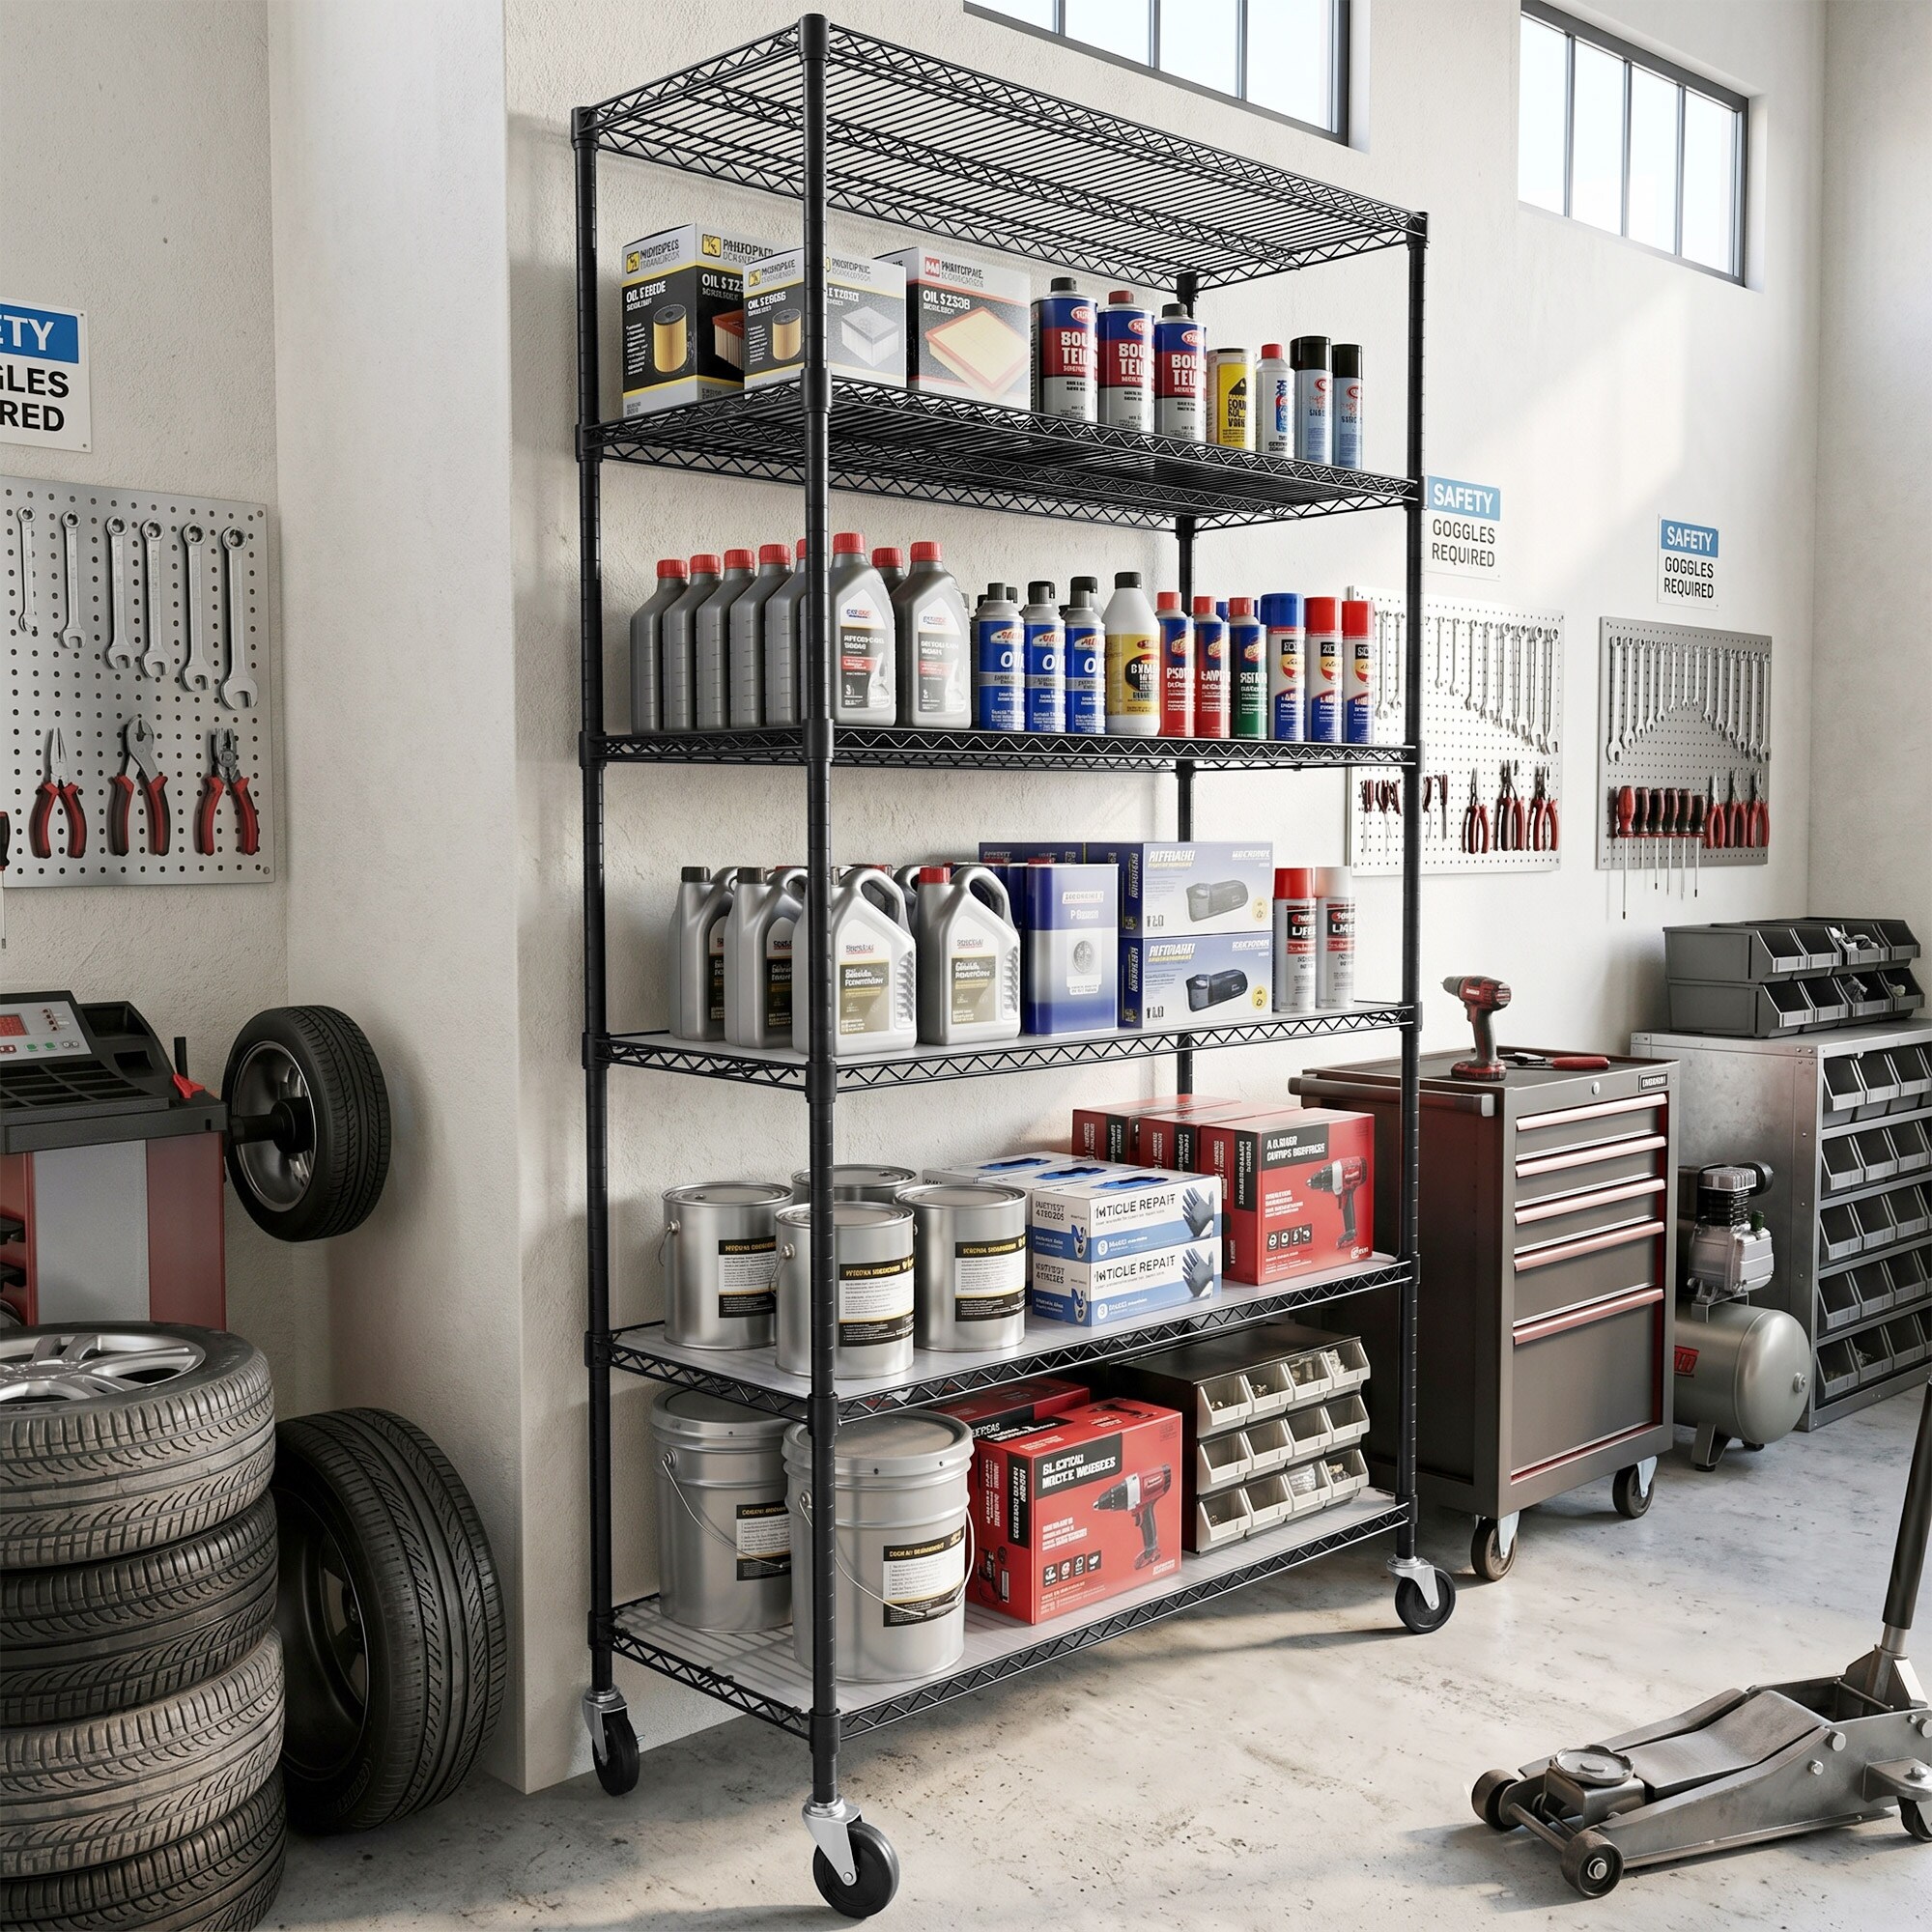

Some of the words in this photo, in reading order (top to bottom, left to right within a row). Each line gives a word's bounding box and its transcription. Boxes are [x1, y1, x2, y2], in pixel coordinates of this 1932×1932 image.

[701, 273, 720, 289] OIL
[923, 290, 939, 304] OIL
[0, 314, 55, 352] TY
[0, 364, 70, 398] LES
[1434, 483, 1493, 514] SAFETY
[1433, 518, 1495, 545] GOGGLES
[1666, 526, 1714, 552] SAFETY
[1432, 542, 1495, 567] REQUIRED
[1664, 556, 1714, 579] GOGGLES
[1663, 577, 1715, 599] REQUIRED
